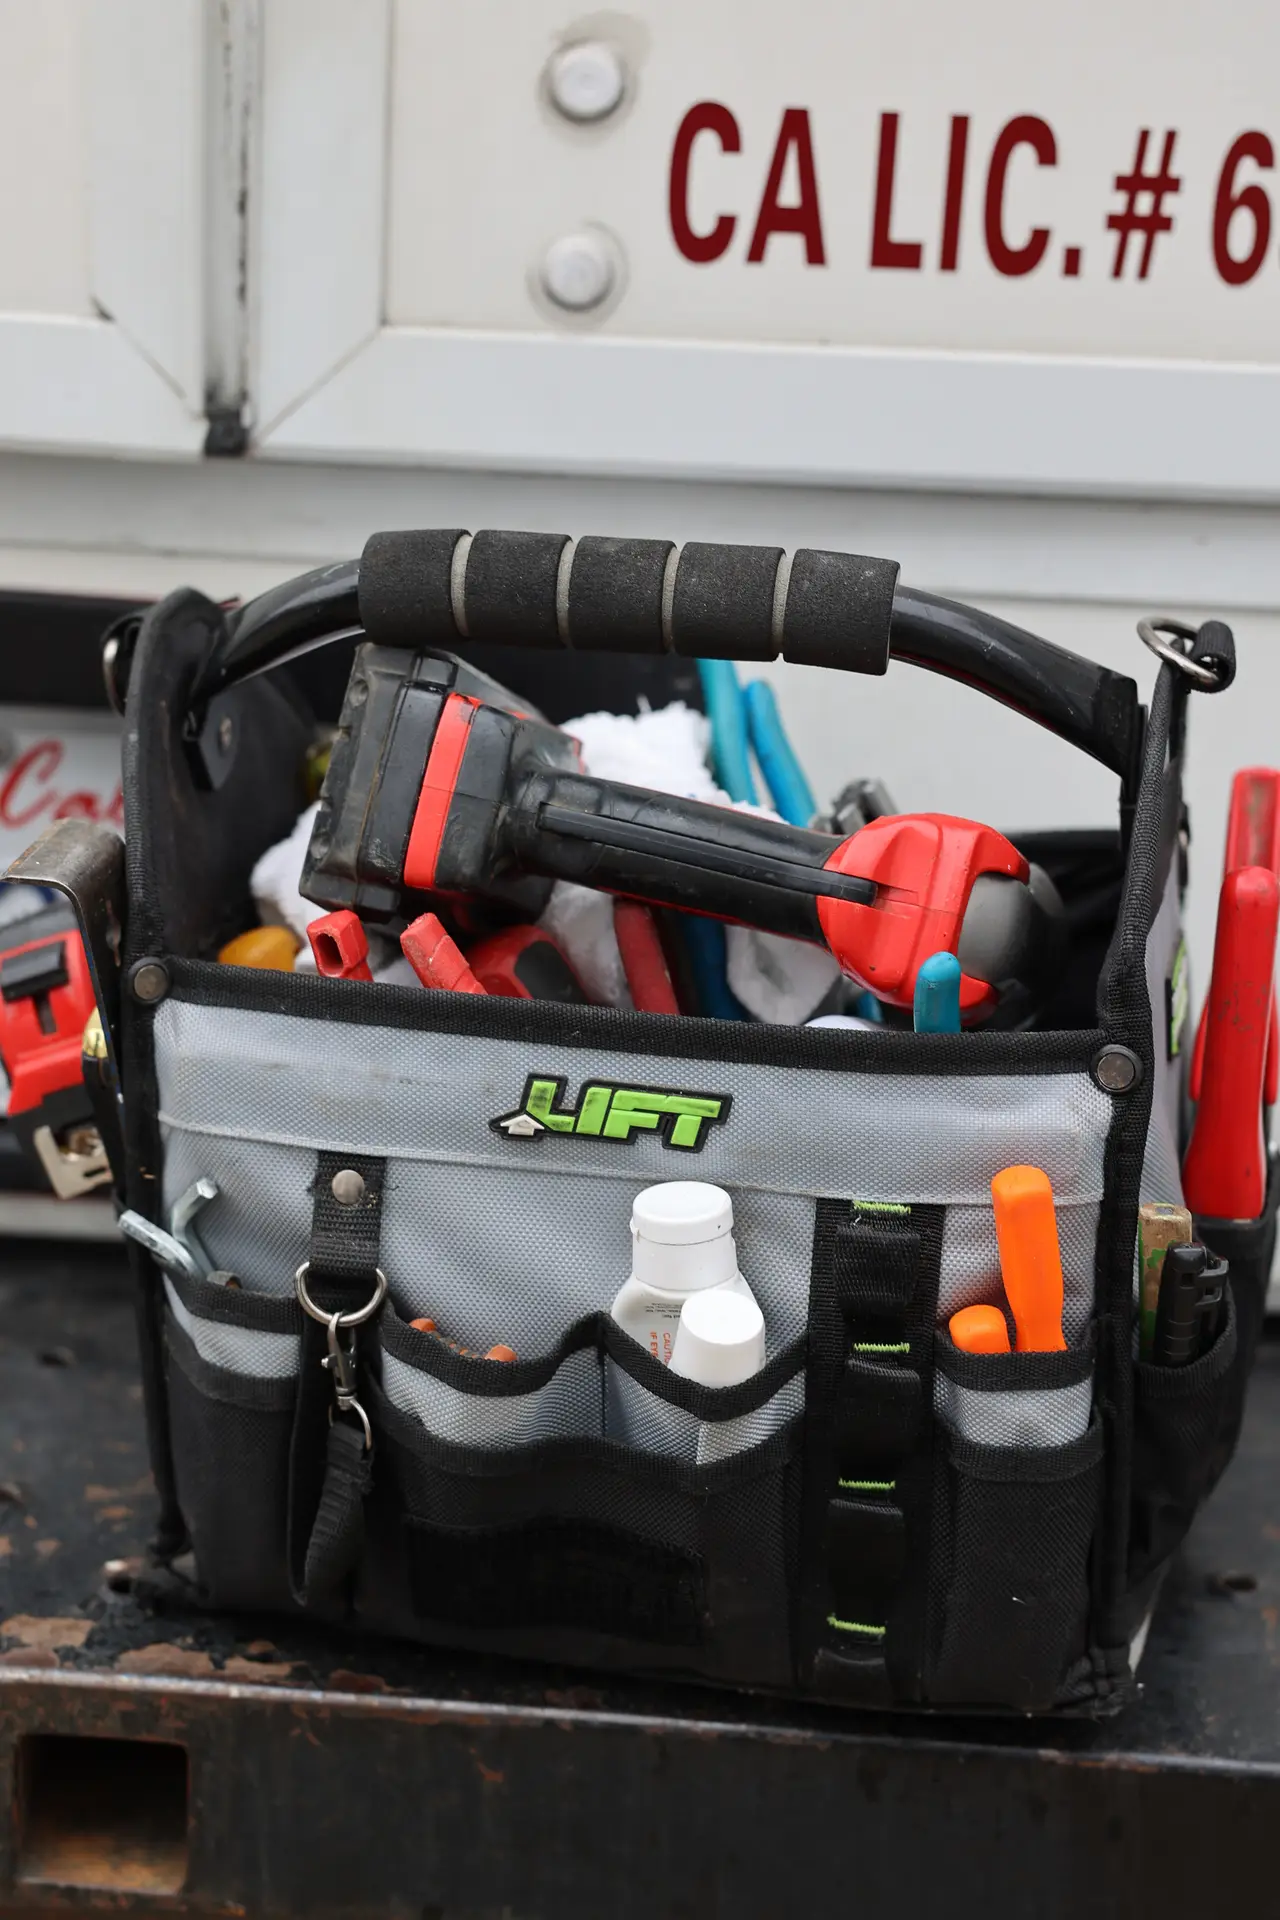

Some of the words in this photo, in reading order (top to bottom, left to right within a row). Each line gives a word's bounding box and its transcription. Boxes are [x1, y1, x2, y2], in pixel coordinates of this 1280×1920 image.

[668, 100, 827, 266] CA
[1211, 130, 1280, 287] 6
[525, 1079, 722, 1148] LIFT
